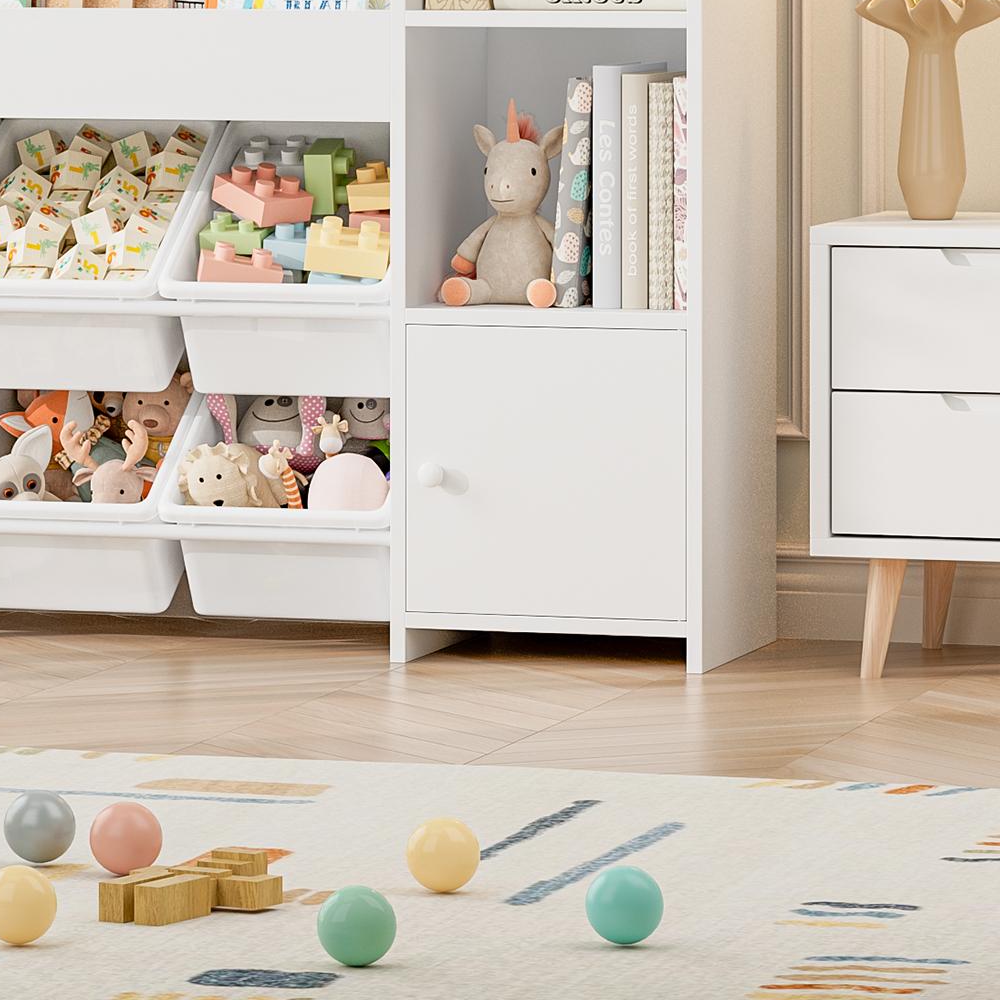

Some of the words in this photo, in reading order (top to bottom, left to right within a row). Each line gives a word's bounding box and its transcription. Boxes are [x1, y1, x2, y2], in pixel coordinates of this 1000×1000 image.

[599, 119, 616, 163] Les
[627, 104, 639, 161] words
[627, 166, 638, 200] first
[599, 171, 616, 256] Contes
[627, 207, 638, 225] of
[627, 231, 638, 277] book
